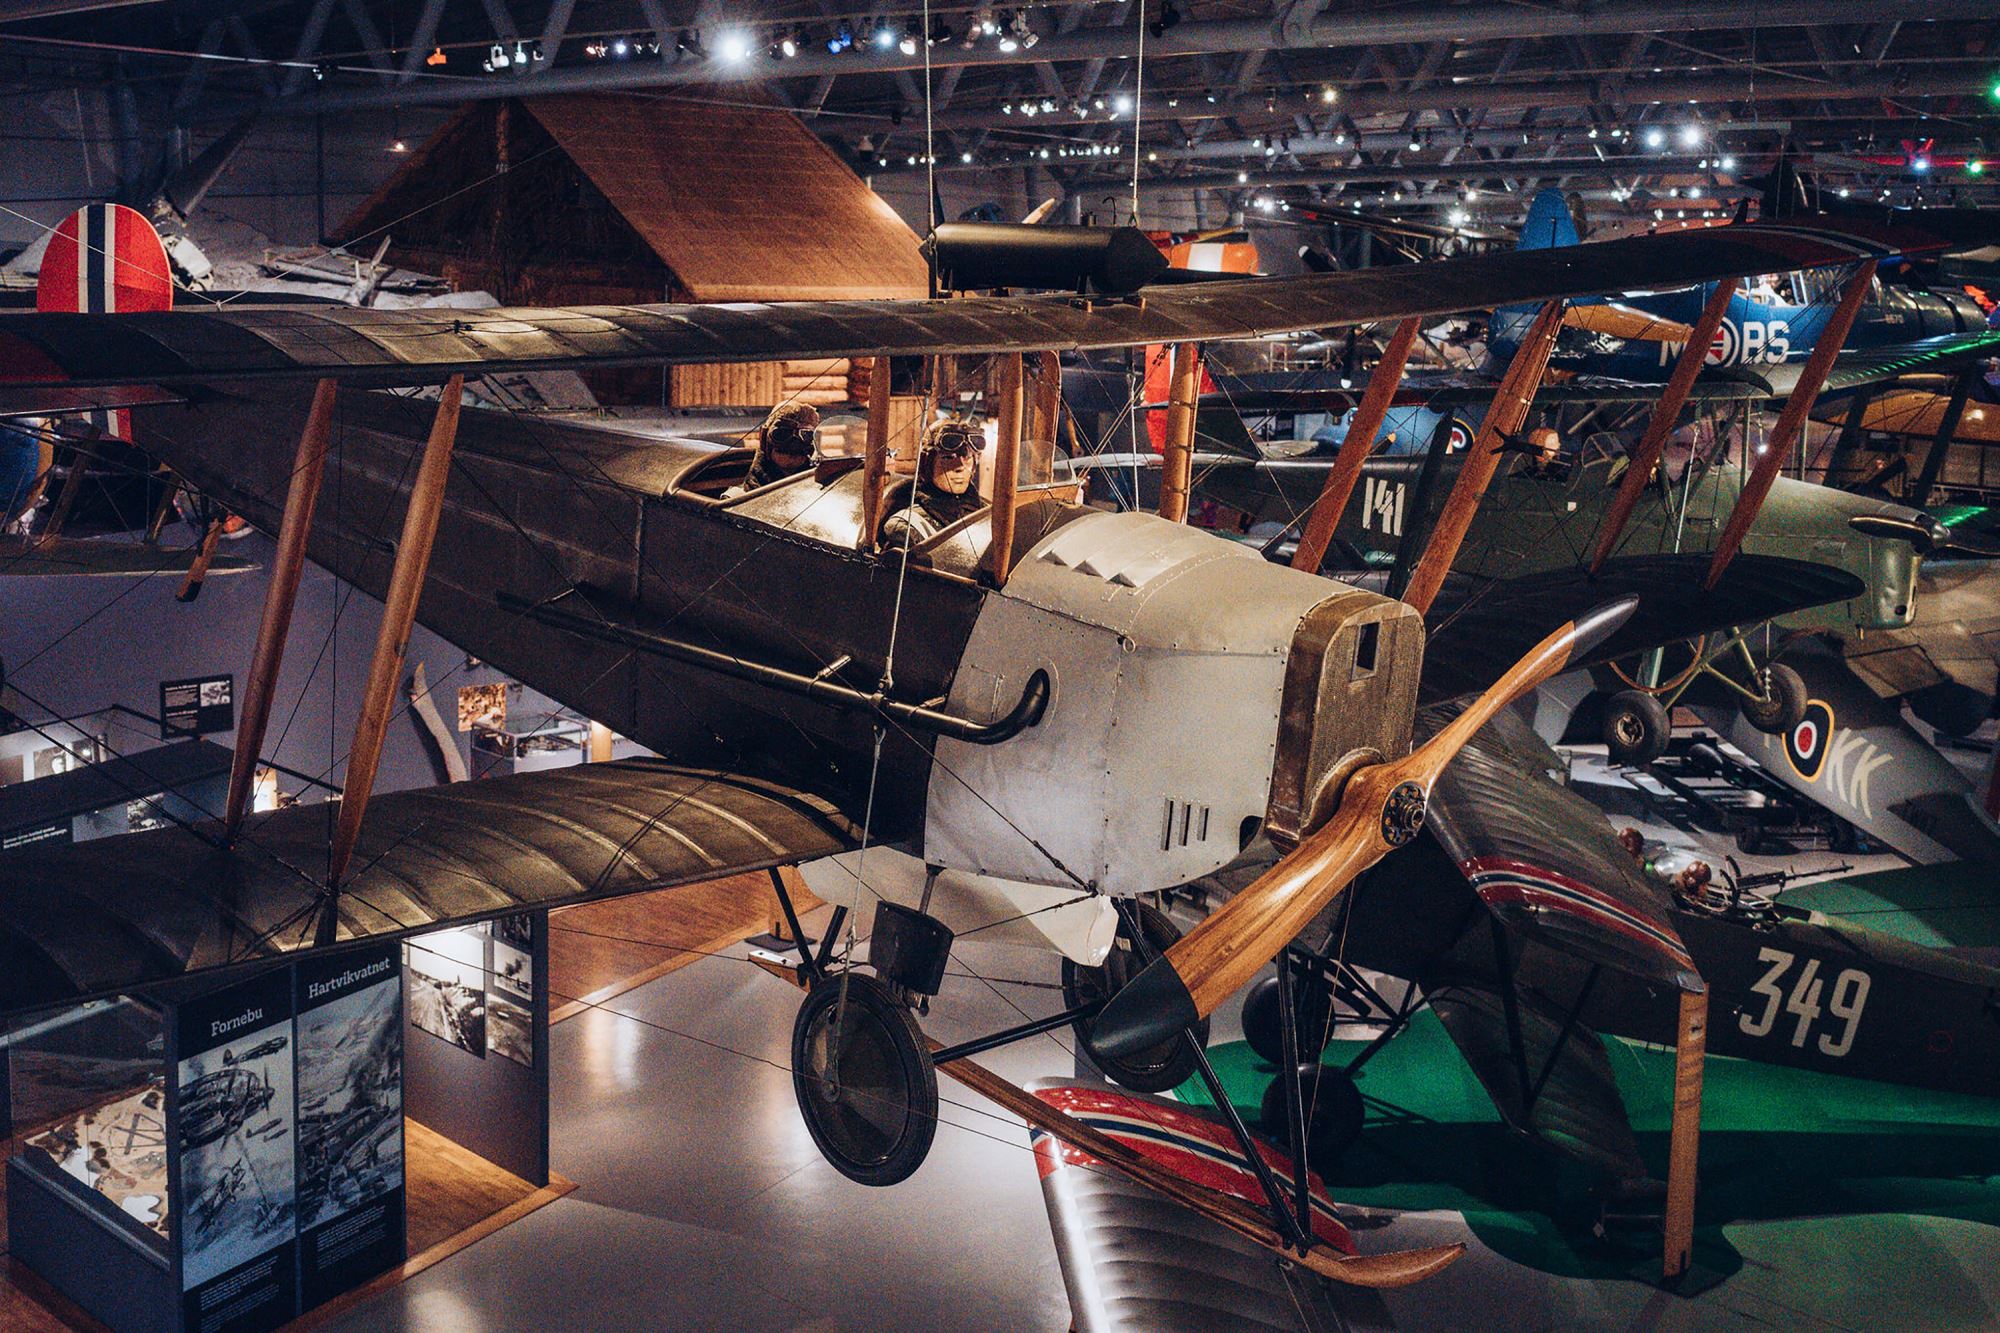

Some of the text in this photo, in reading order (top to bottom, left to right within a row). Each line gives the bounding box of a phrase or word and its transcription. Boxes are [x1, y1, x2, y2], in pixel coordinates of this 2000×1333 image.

[1826, 727, 1894, 820] KK
[308, 957, 391, 999] Hartvikvatnet
[1738, 946, 1871, 1057] 349
[210, 1007, 264, 1037] Fornebu
